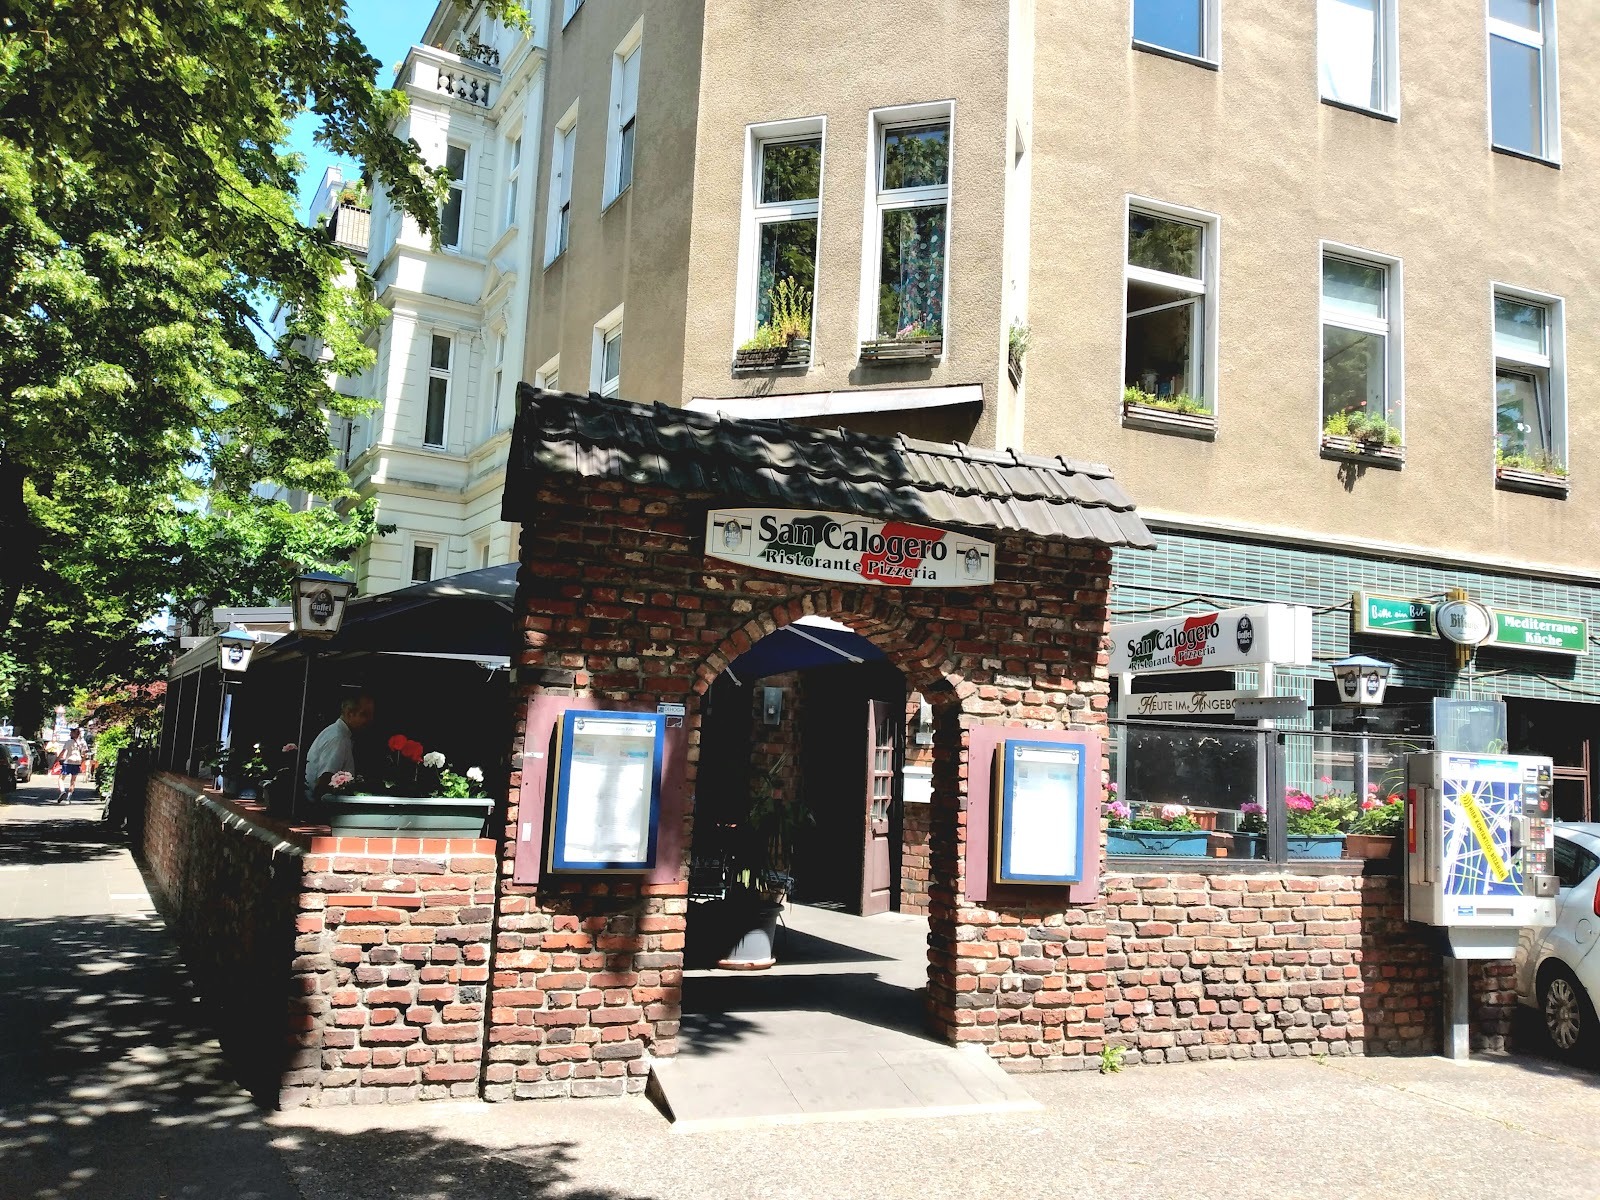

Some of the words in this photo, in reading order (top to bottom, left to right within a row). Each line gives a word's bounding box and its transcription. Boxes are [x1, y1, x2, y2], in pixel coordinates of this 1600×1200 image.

[758, 515, 813, 546] San
[823, 522, 947, 564] Calogero
[766, 549, 861, 572] Ristorante
[868, 560, 936, 580] Pizzeria
[1409, 605, 1426, 618] Bit
[1504, 616, 1578, 634] Mediterrane
[1127, 639, 1153, 657] San
[1156, 622, 1219, 650] Calogero
[1525, 631, 1563, 646] Küche
[1131, 655, 1175, 671] Ristorante
[1178, 645, 1215, 661] Pizzeria
[1138, 694, 1172, 714] HEUTE
[1175, 701, 1187, 710] IM
[1469, 806, 1477, 819] HIER
[1475, 819, 1493, 853] KONTAKTLOS
[1490, 852, 1505, 879] BEZAHLEN
